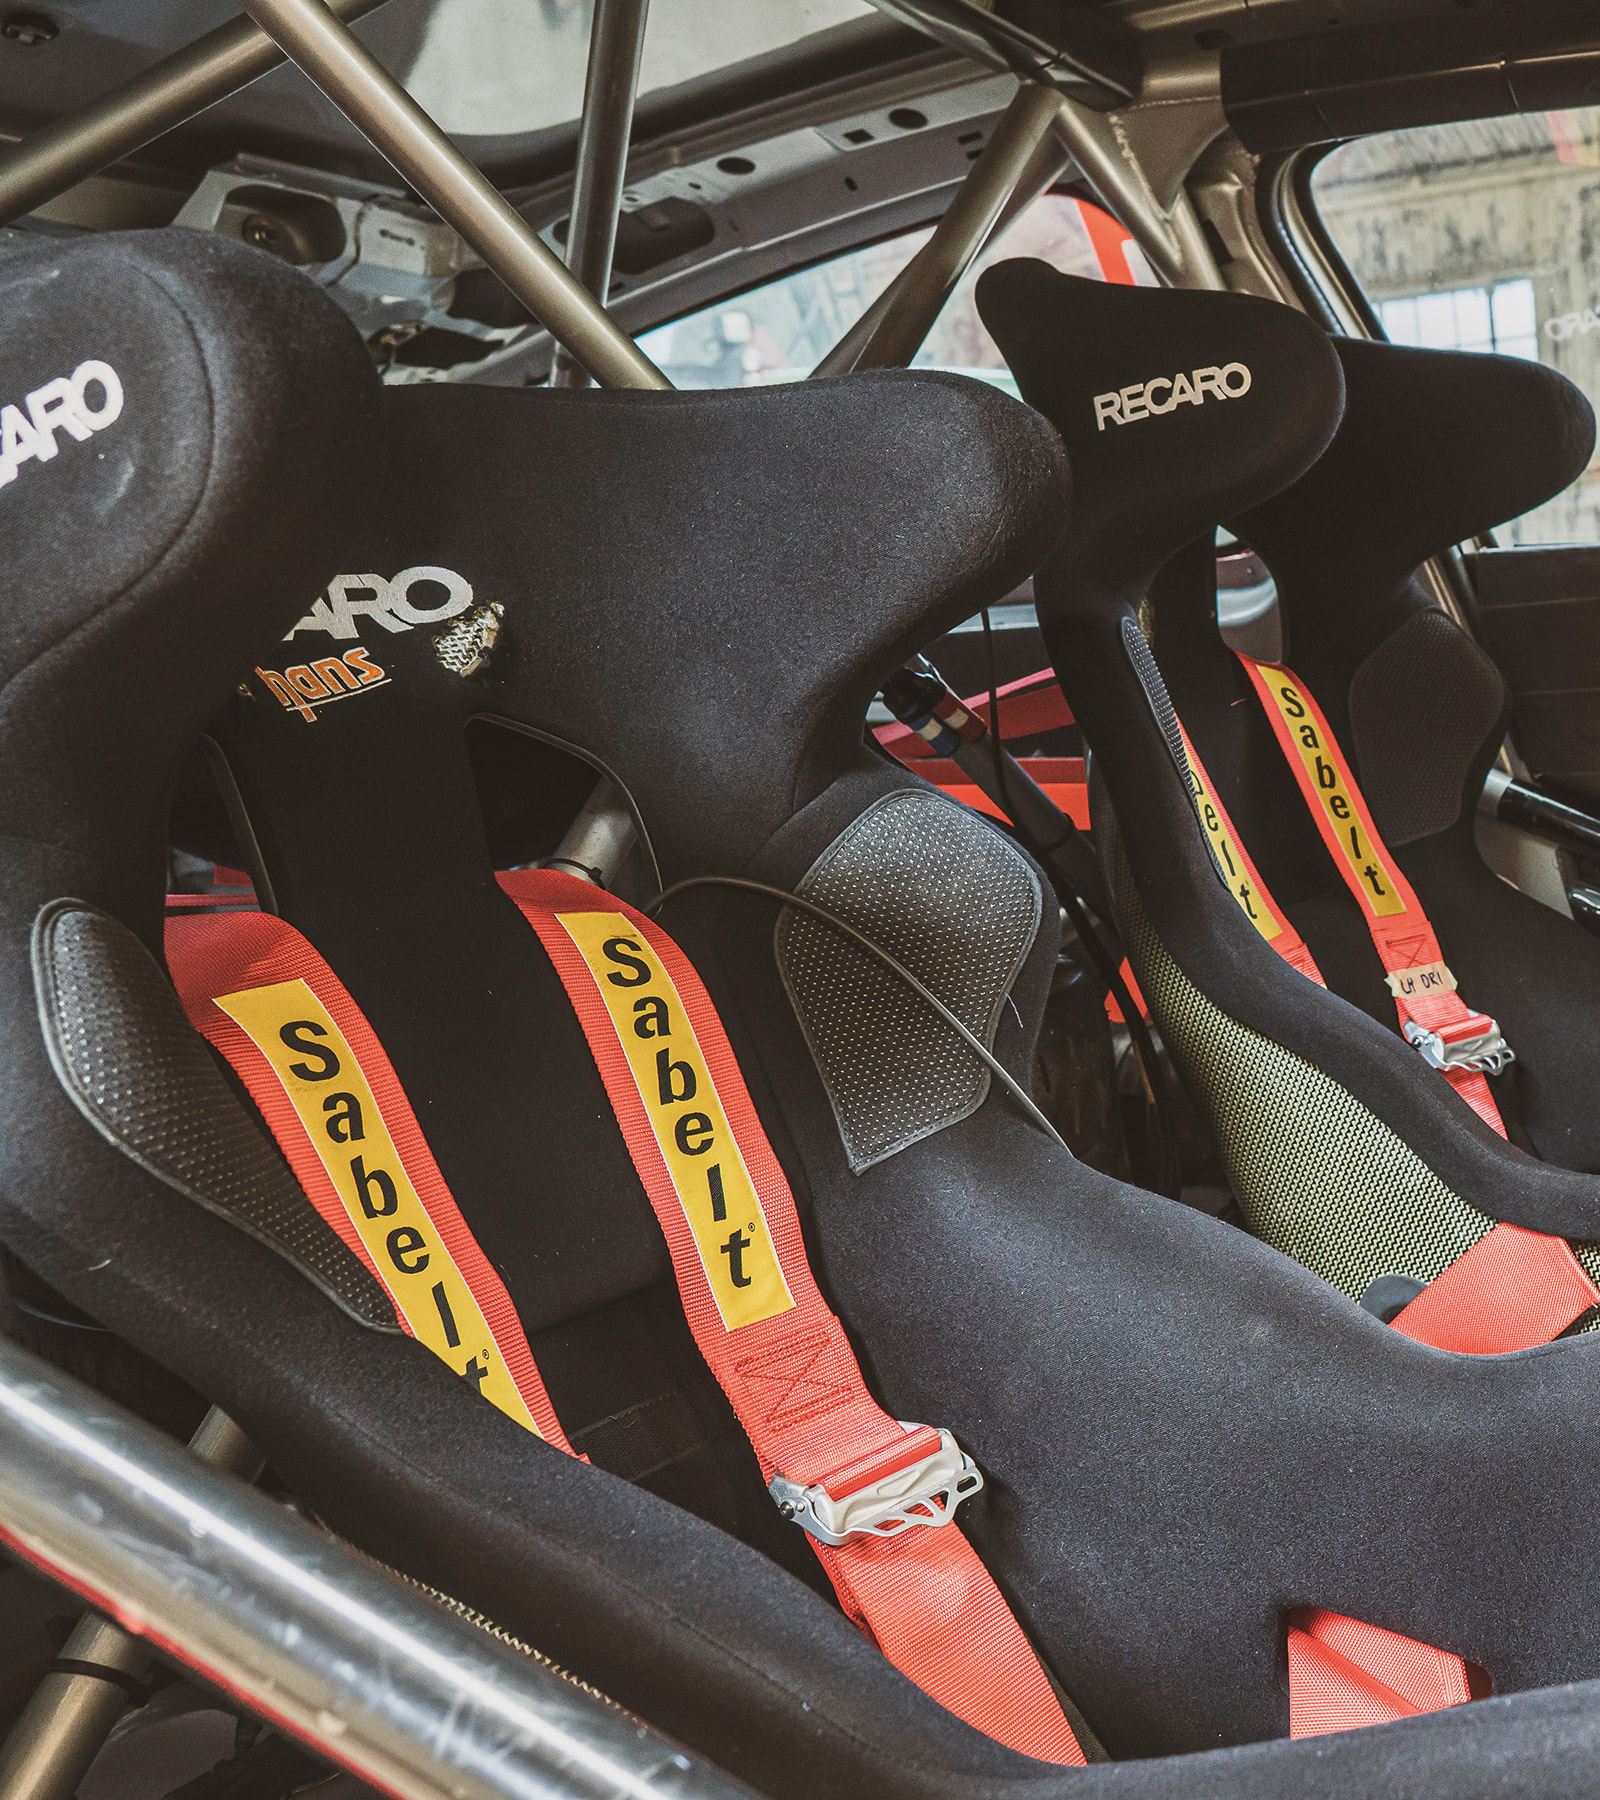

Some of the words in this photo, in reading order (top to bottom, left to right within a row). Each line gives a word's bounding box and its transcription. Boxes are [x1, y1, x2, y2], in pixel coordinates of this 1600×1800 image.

[0, 360, 124, 489] ARO
[1093, 362, 1252, 431] RECARO
[281, 566, 474, 640] ARO
[254, 646, 387, 723] hans
[1280, 687, 1386, 896] Sabelt
[601, 937, 752, 1289] Sabelt
